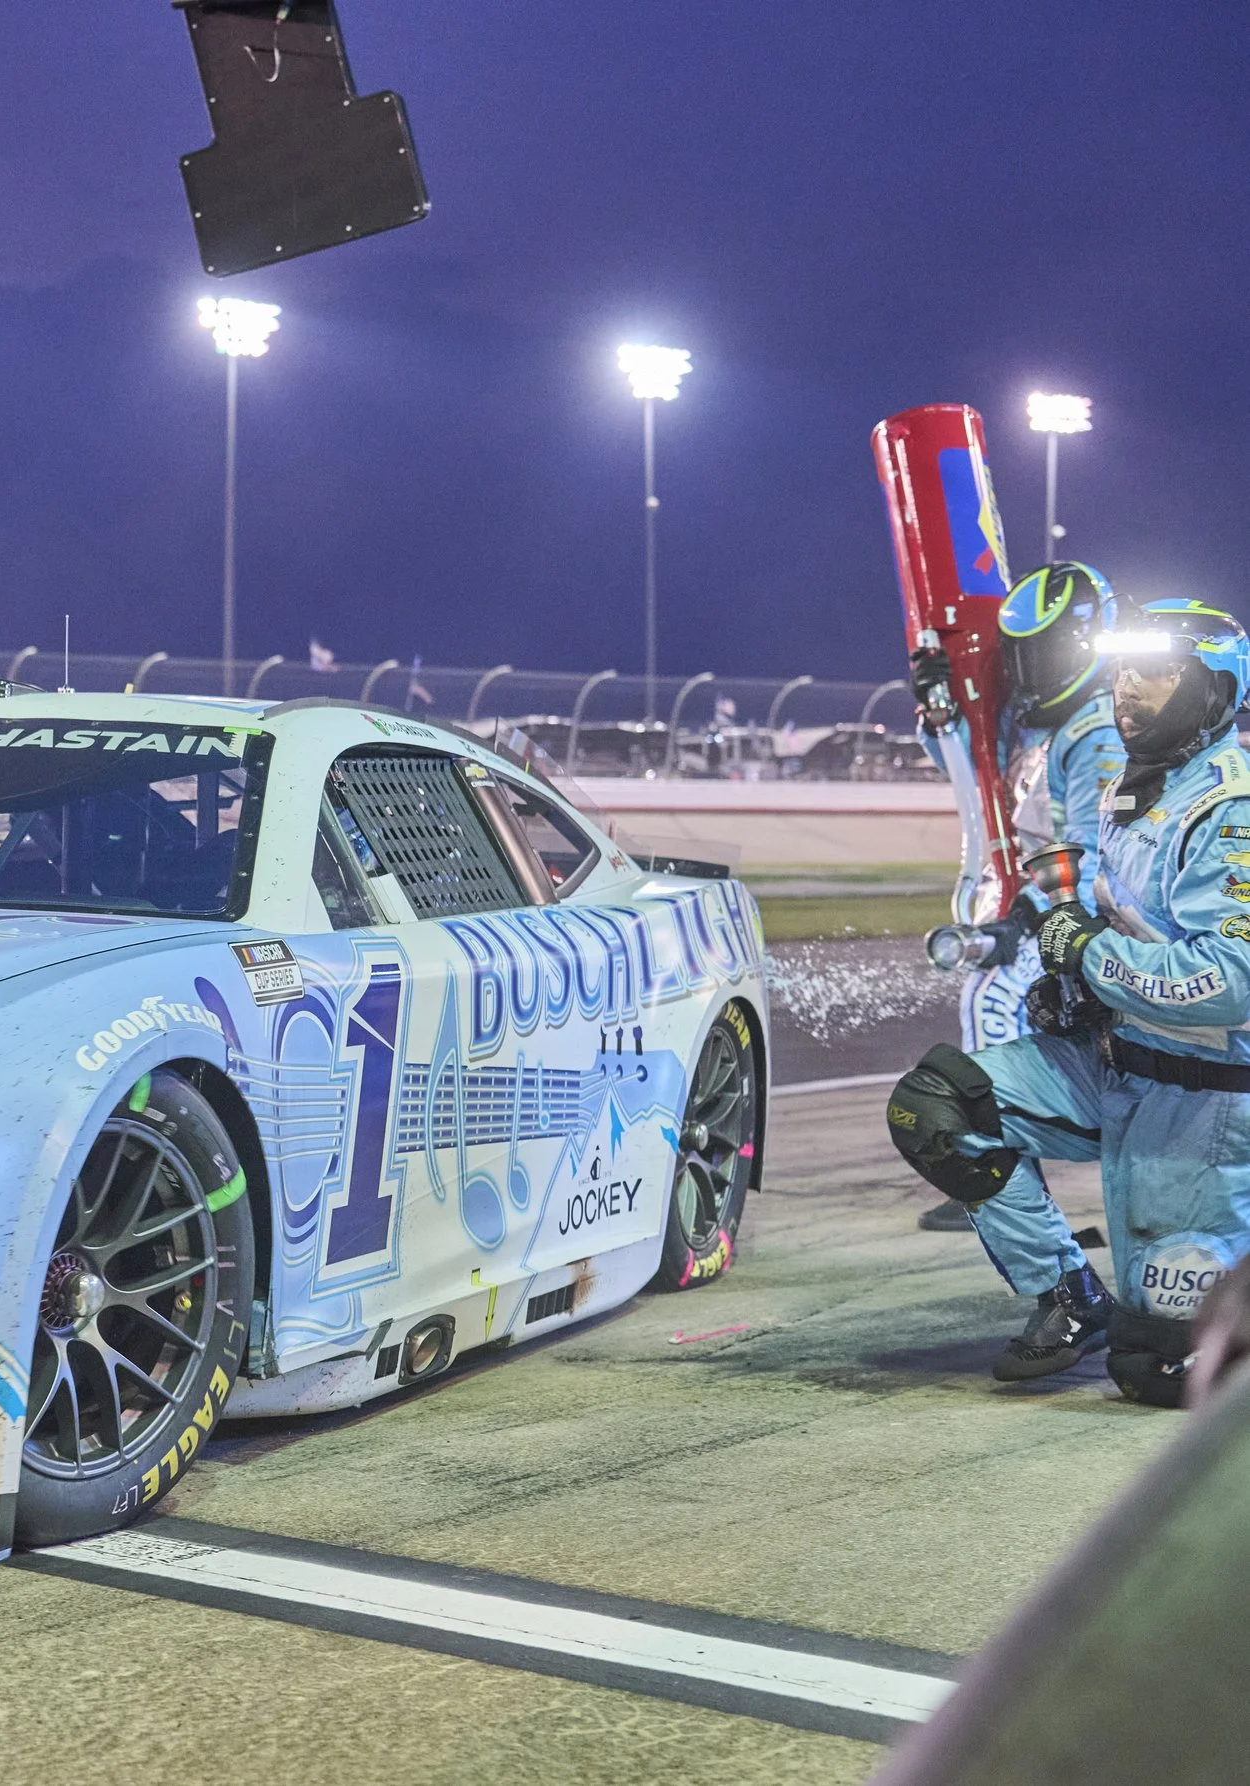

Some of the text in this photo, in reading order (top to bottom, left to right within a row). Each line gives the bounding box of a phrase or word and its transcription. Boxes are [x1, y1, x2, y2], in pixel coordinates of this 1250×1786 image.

[251, 942, 286, 963] NASCAR
[254, 967, 295, 990] CUP SERIES
[438, 904, 638, 1062] BUSCH
[75, 998, 226, 1073] GOODYEAR
[317, 952, 405, 1280] 1
[558, 1177, 643, 1236] JOCKEY
[141, 1363, 230, 1504] EAGLE
